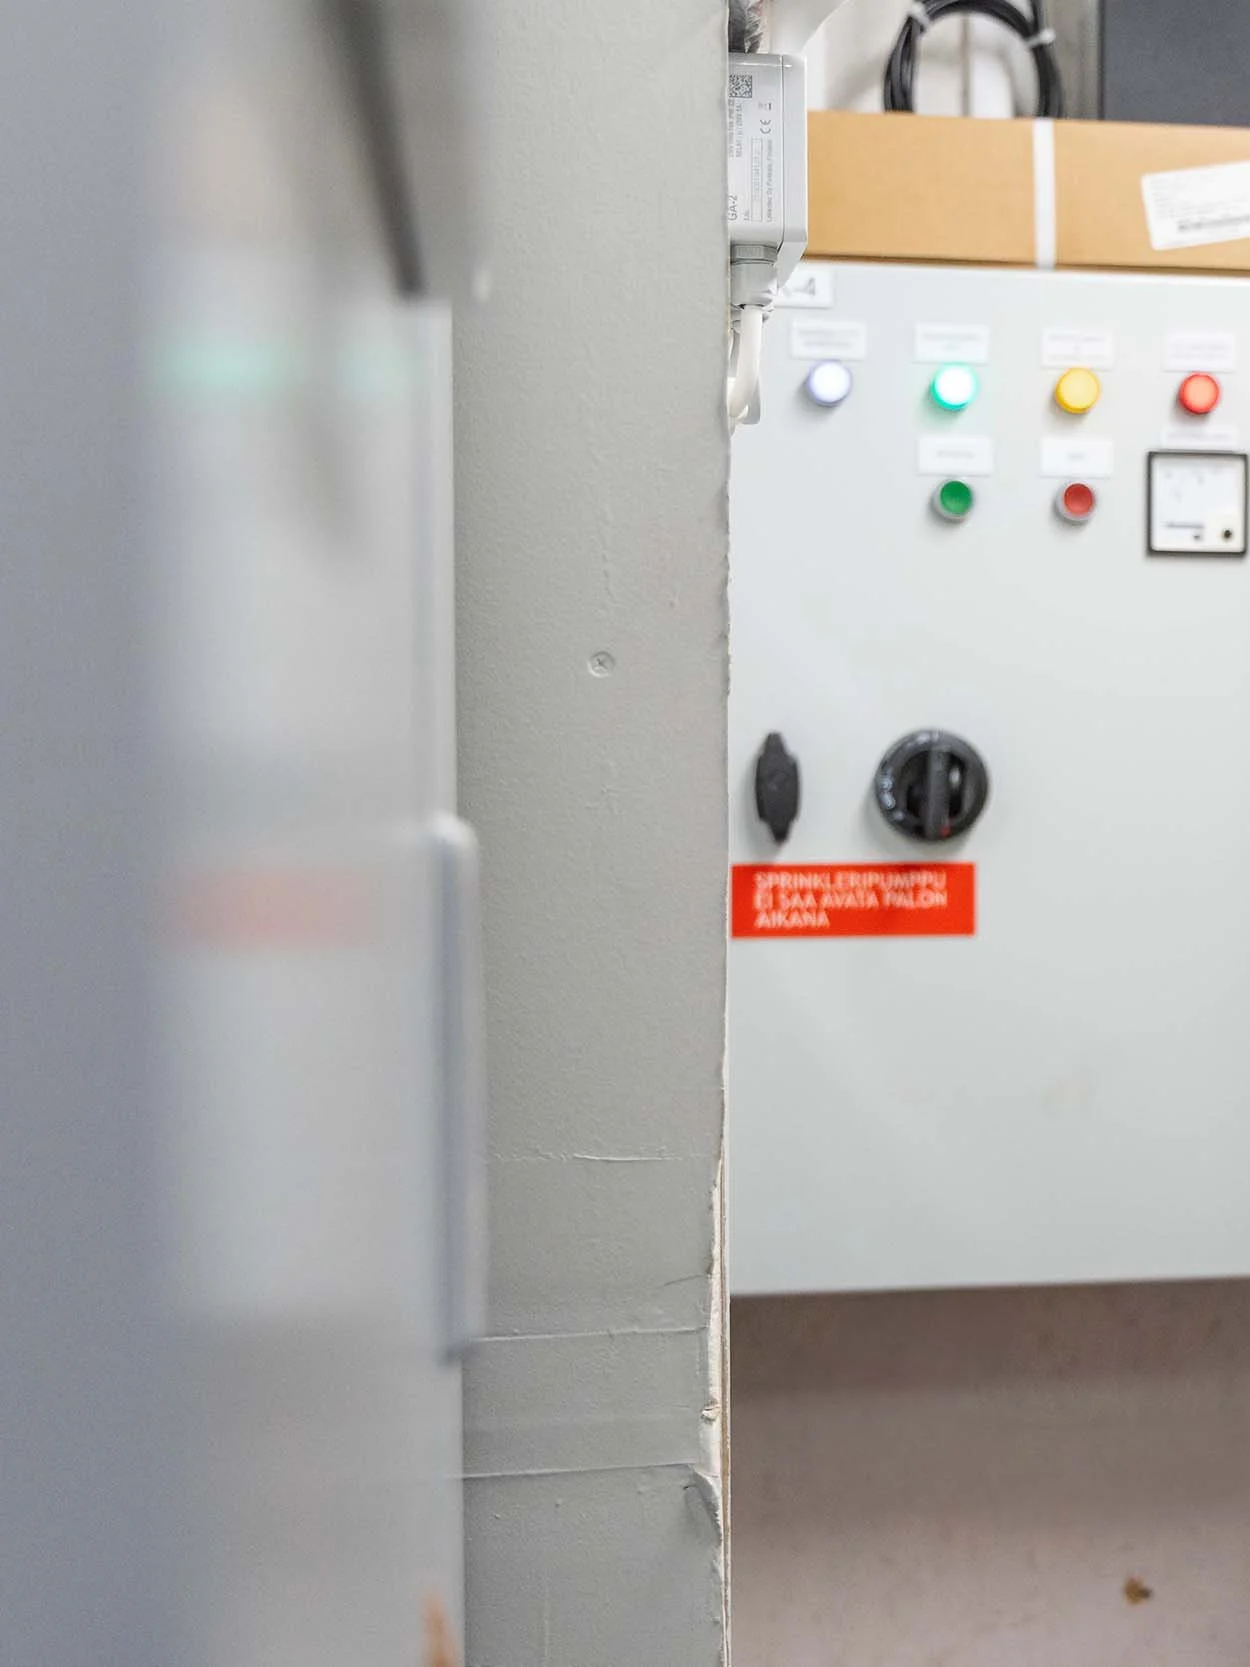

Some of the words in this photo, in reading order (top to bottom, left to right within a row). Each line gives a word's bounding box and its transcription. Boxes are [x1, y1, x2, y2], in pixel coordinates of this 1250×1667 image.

[754, 871, 947, 890] SPRINKLERIPUMPPU
[754, 888, 773, 908] EI
[779, 889, 816, 908] SAA
[819, 887, 880, 908] AVATA
[754, 909, 831, 929] AIKANA
